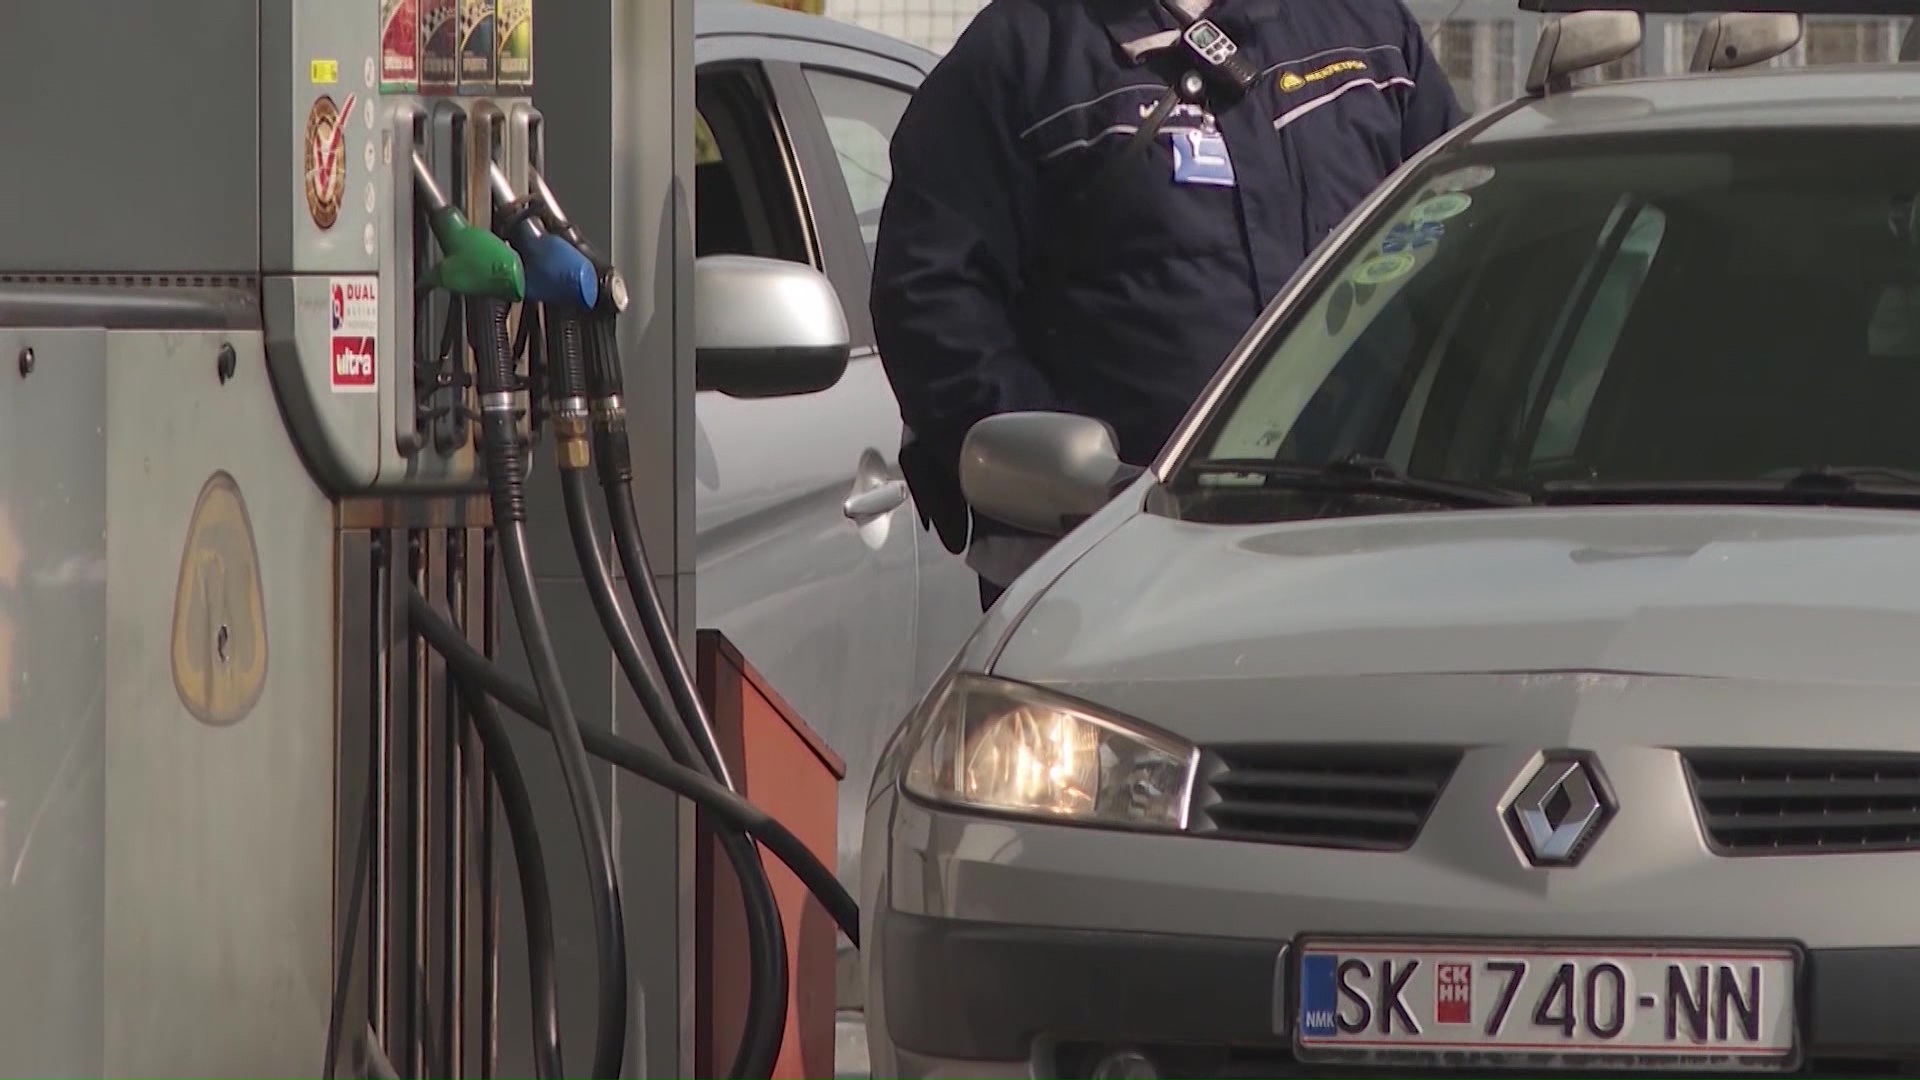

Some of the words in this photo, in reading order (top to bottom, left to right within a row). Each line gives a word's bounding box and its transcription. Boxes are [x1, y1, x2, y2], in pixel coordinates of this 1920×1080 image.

[346, 284, 375, 299] DUAL
[336, 346, 372, 376] ultra
[1337, 959, 1420, 1035] SK
[1486, 962, 1760, 1042] 740-NN
[1306, 1010, 1335, 1028] NMK
